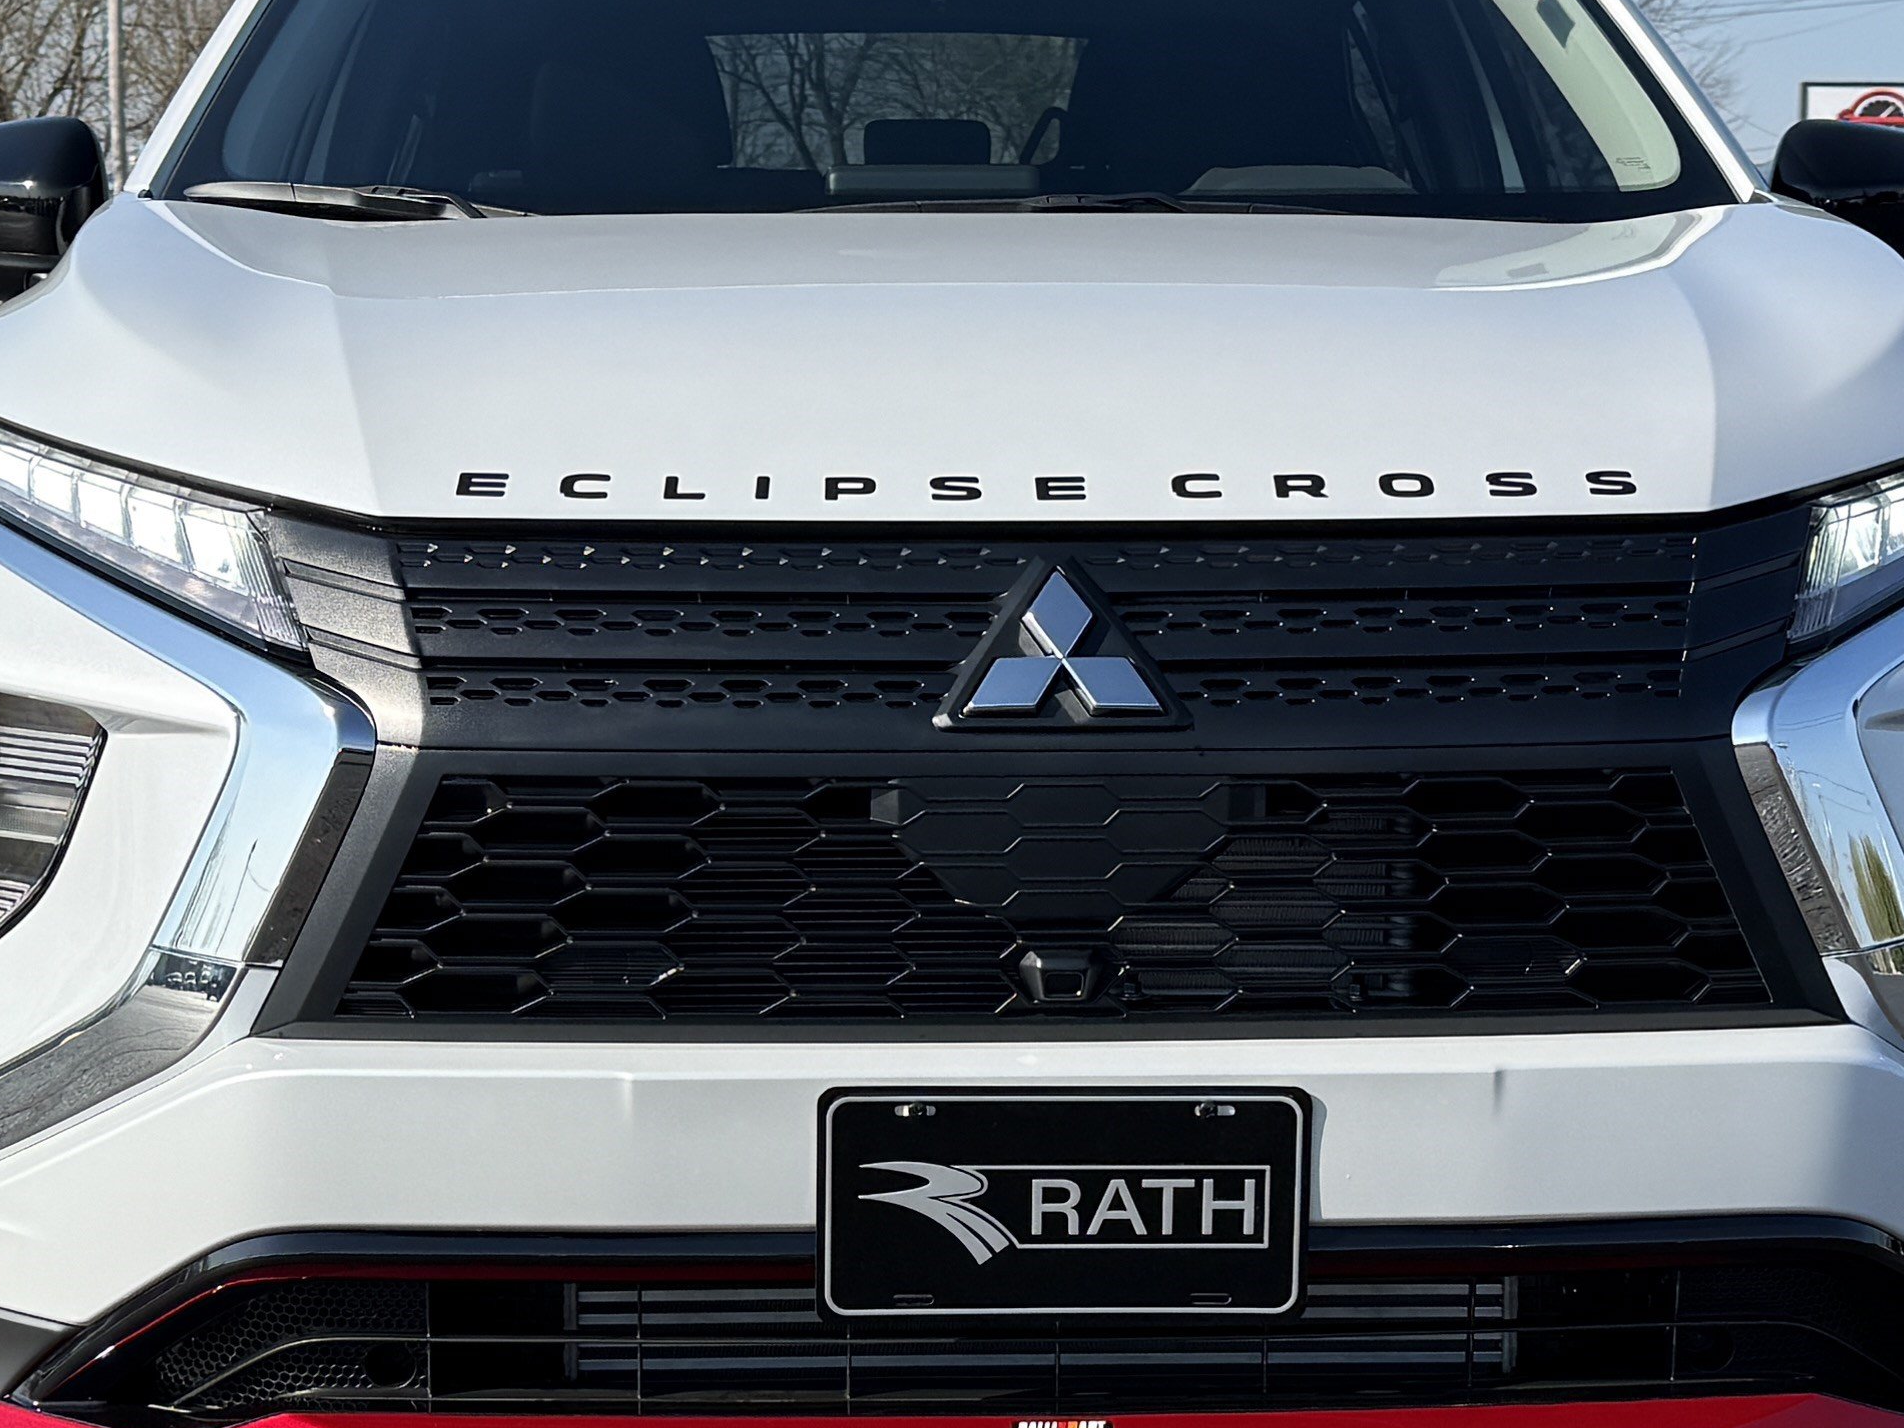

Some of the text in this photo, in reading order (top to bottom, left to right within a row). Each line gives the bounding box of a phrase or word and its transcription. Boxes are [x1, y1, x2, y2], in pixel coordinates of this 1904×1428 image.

[456, 470, 1639, 502] ECLIPSE CROSS
[1031, 1178, 1256, 1236] RATH
